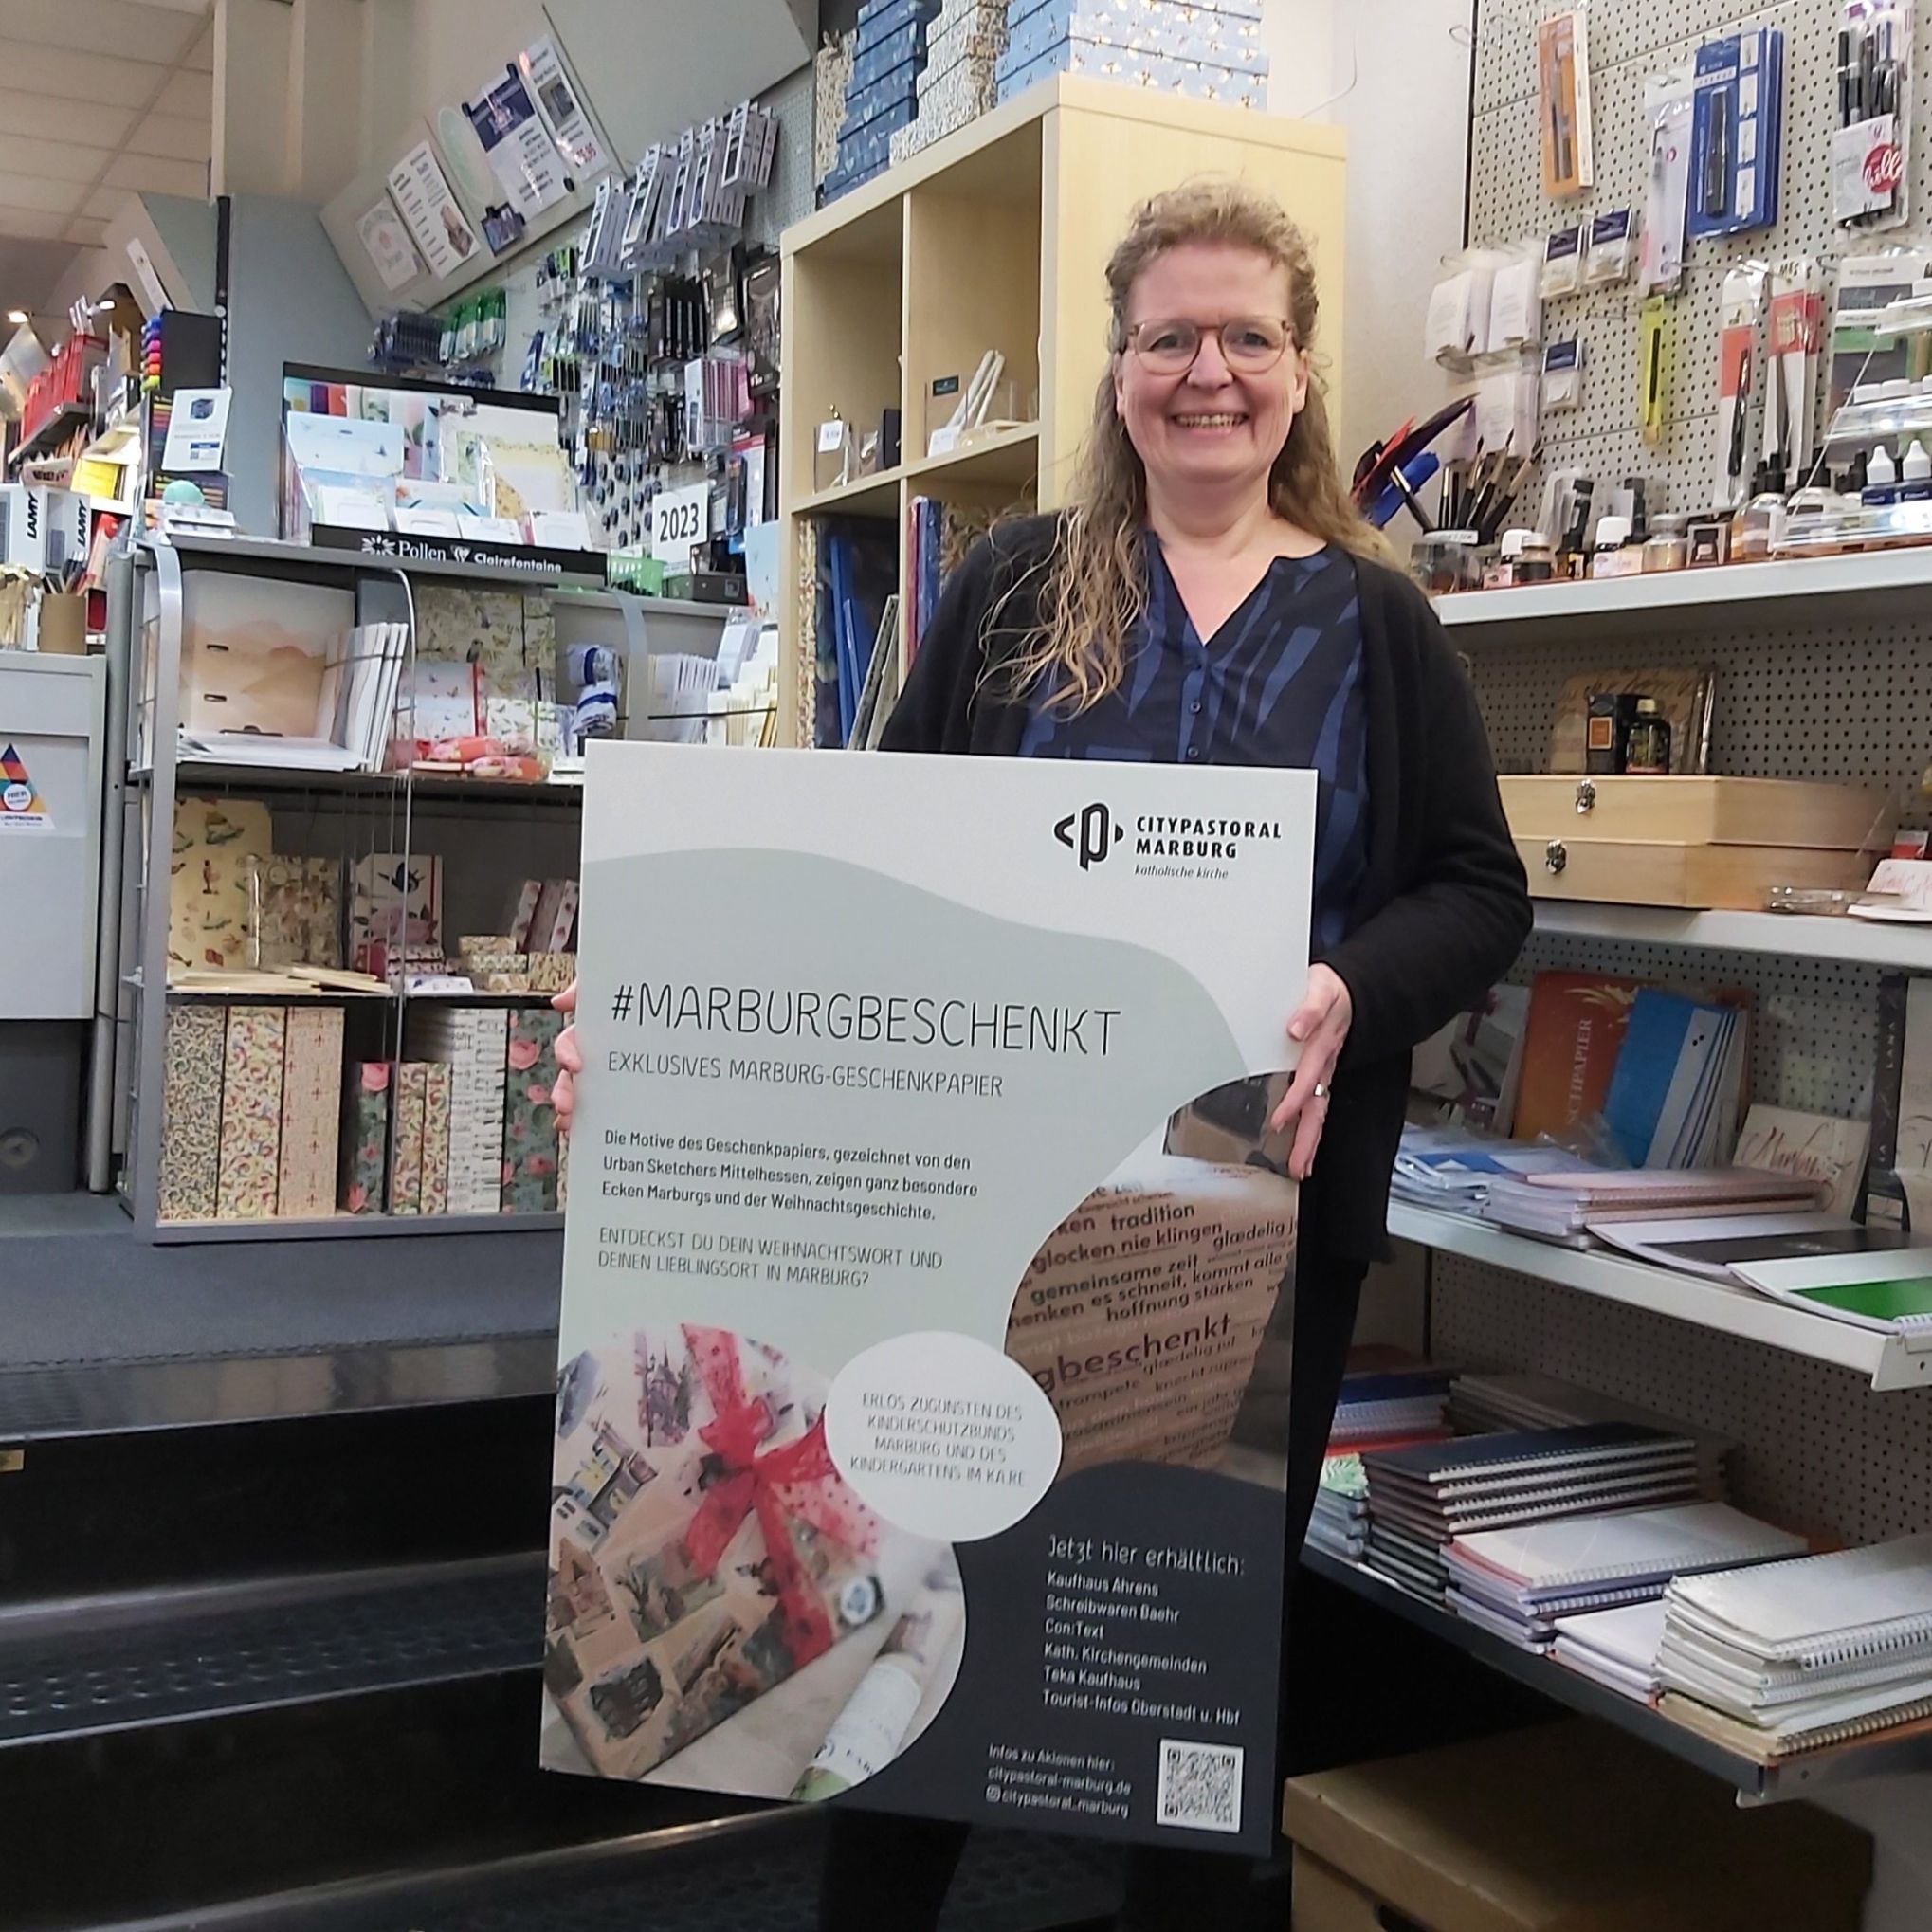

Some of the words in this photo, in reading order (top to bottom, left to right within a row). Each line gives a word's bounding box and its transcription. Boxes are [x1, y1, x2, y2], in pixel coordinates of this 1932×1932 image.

[27, 490, 39, 539] LAMY
[77, 498, 87, 547] LAMY
[659, 502, 699, 542] 2023
[398, 541, 447, 562] Pollen
[474, 552, 562, 573] Clairefontaine
[1137, 816, 1282, 839] CITYPASTORAL
[1136, 838, 1237, 859] MARBURG
[1135, 864, 1194, 879] katholische
[1196, 866, 1229, 880] kirche
[611, 982, 1121, 1056] #MARBURGBESCHENKT
[608, 1051, 721, 1079] EXKLUSIVES
[729, 1059, 1004, 1098] MARBURG-GESCHENKPAPIER
[604, 1129, 627, 1145] Die
[629, 1132, 675, 1150] Motive
[678, 1136, 702, 1151] des
[706, 1137, 830, 1161] Geschenkpapiers,
[833, 1146, 911, 1166] gezeichnet
[915, 1154, 940, 1168] von
[943, 1154, 971, 1171] den
[603, 1156, 644, 1174] Urban
[647, 1158, 717, 1177] Sketchers
[720, 1163, 812, 1187] Mittelhessen,
[815, 1170, 862, 1191] zeigen
[866, 1176, 899, 1193] ganz
[902, 1177, 978, 1198] besondere
[602, 1181, 644, 1199] Ecken
[647, 1184, 712, 1206] Marburgs
[715, 1190, 740, 1207] und
[744, 1192, 767, 1208] der
[771, 1194, 936, 1221] Weihnachtsgeschichte.
[1110, 1204, 1195, 1231] tradition
[599, 1227, 685, 1250] ENTDECKST
[691, 1233, 714, 1252] DU
[719, 1235, 754, 1254] DEIN
[758, 1239, 903, 1267] WEIHNACHTSWORT
[910, 1249, 943, 1269] UND
[1031, 1242, 1115, 1274] glocken
[1121, 1234, 1151, 1253] nie
[1156, 1221, 1223, 1247] klingen
[598, 1250, 651, 1271] DEINEN
[656, 1254, 758, 1279] LIEBLINGSORT
[766, 1263, 781, 1281] IN
[786, 1266, 870, 1287] MARBURG?
[1030, 1264, 1162, 1305] gemeinsame
[1168, 1253, 1198, 1273] zeit
[1091, 1291, 1113, 1306] es
[1119, 1276, 1187, 1303] schneit,
[1193, 1259, 1249, 1285] kommt
[1254, 1252, 1283, 1272] alle
[1106, 1290, 1190, 1322] hoffnung
[1032, 1312, 1230, 1394] gbeschenkt
[863, 1392, 905, 1412] ERLÖS
[910, 1396, 992, 1419] ZUGUNSTEN
[995, 1404, 1023, 1421] DES
[867, 1413, 1015, 1443] KINDERSCHUTZBUNDS
[874, 1436, 941, 1457] MARBURG
[946, 1444, 975, 1460] UND
[979, 1447, 1007, 1463] DES
[850, 1455, 962, 1481] KINDERGARTENS
[967, 1467, 981, 1483] IM
[1048, 1534, 1093, 1564] Jetzt
[1102, 1540, 1138, 1564] hier
[1145, 1546, 1245, 1576] erhältlich:
[1047, 1570, 1109, 1593] Kaufhaus
[1112, 1577, 1158, 1597] Ahrens
[1046, 1594, 1138, 1619] Schreibwaren
[1044, 1642, 1079, 1661] Kath.
[1082, 1646, 1208, 1675] Kirchengemeinden
[1079, 1668, 1140, 1691] Kaufhaus
[1043, 1688, 1128, 1714] Tourist-Infos
[1131, 1698, 1196, 1722] Oberstadt
[989, 1743, 1019, 1760] Infos
[1021, 1750, 1035, 1763] zu
